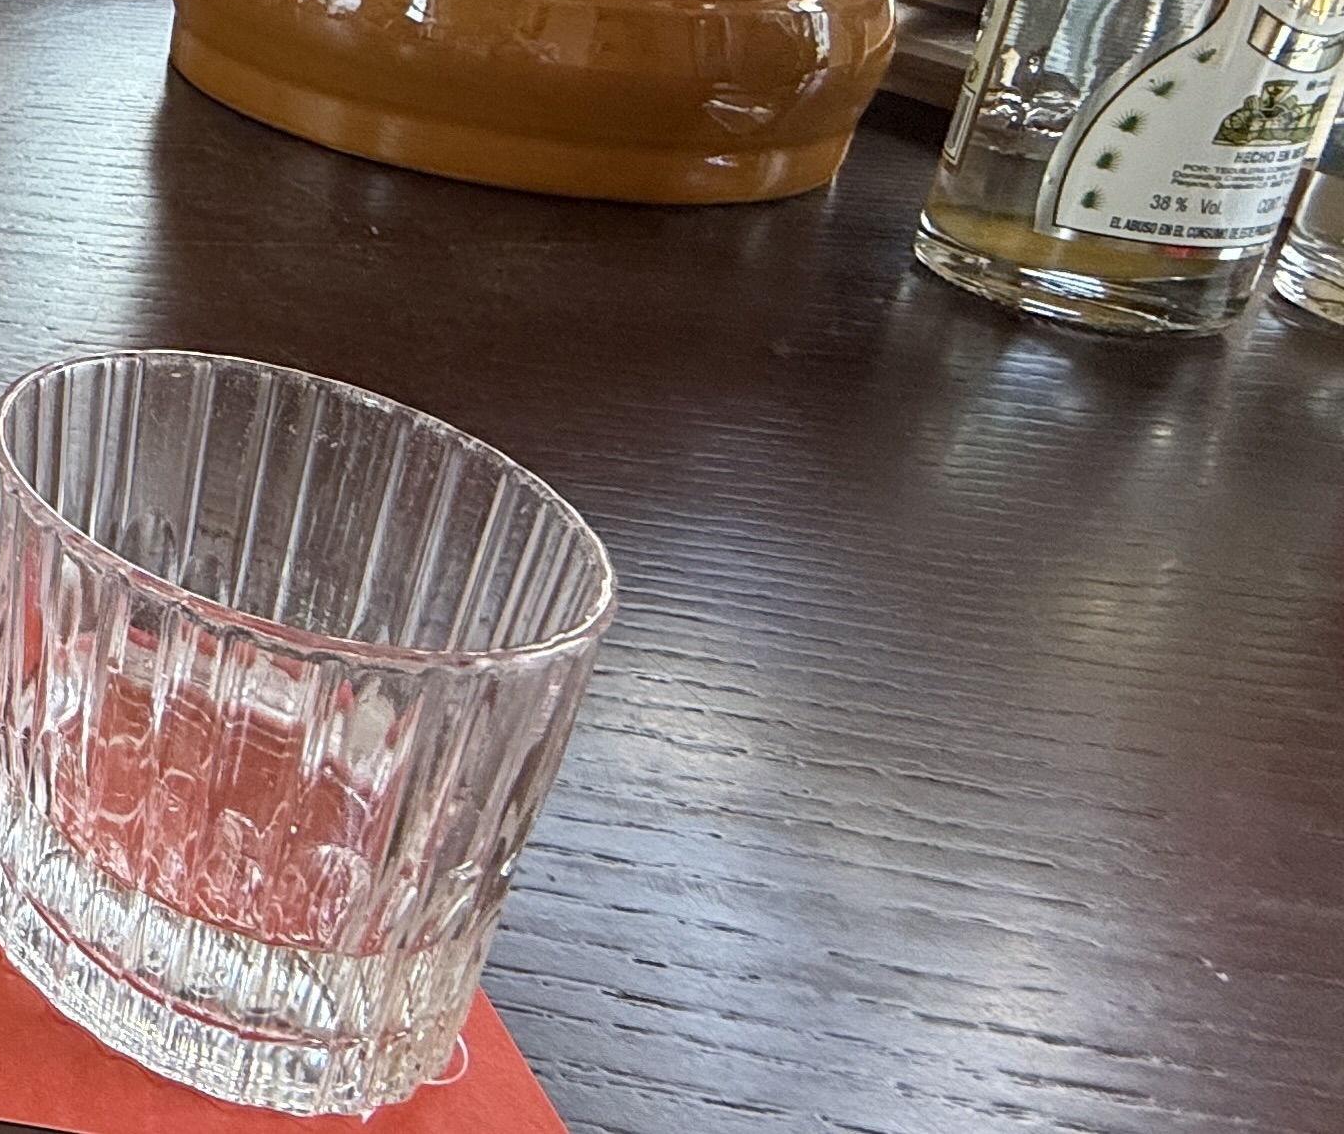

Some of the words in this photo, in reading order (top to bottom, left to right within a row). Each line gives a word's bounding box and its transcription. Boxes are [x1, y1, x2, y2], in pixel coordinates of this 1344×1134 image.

[1149, 194, 1171, 211] 38
[1109, 216, 1122, 229] EL
[1123, 219, 1158, 235] ABUSO
